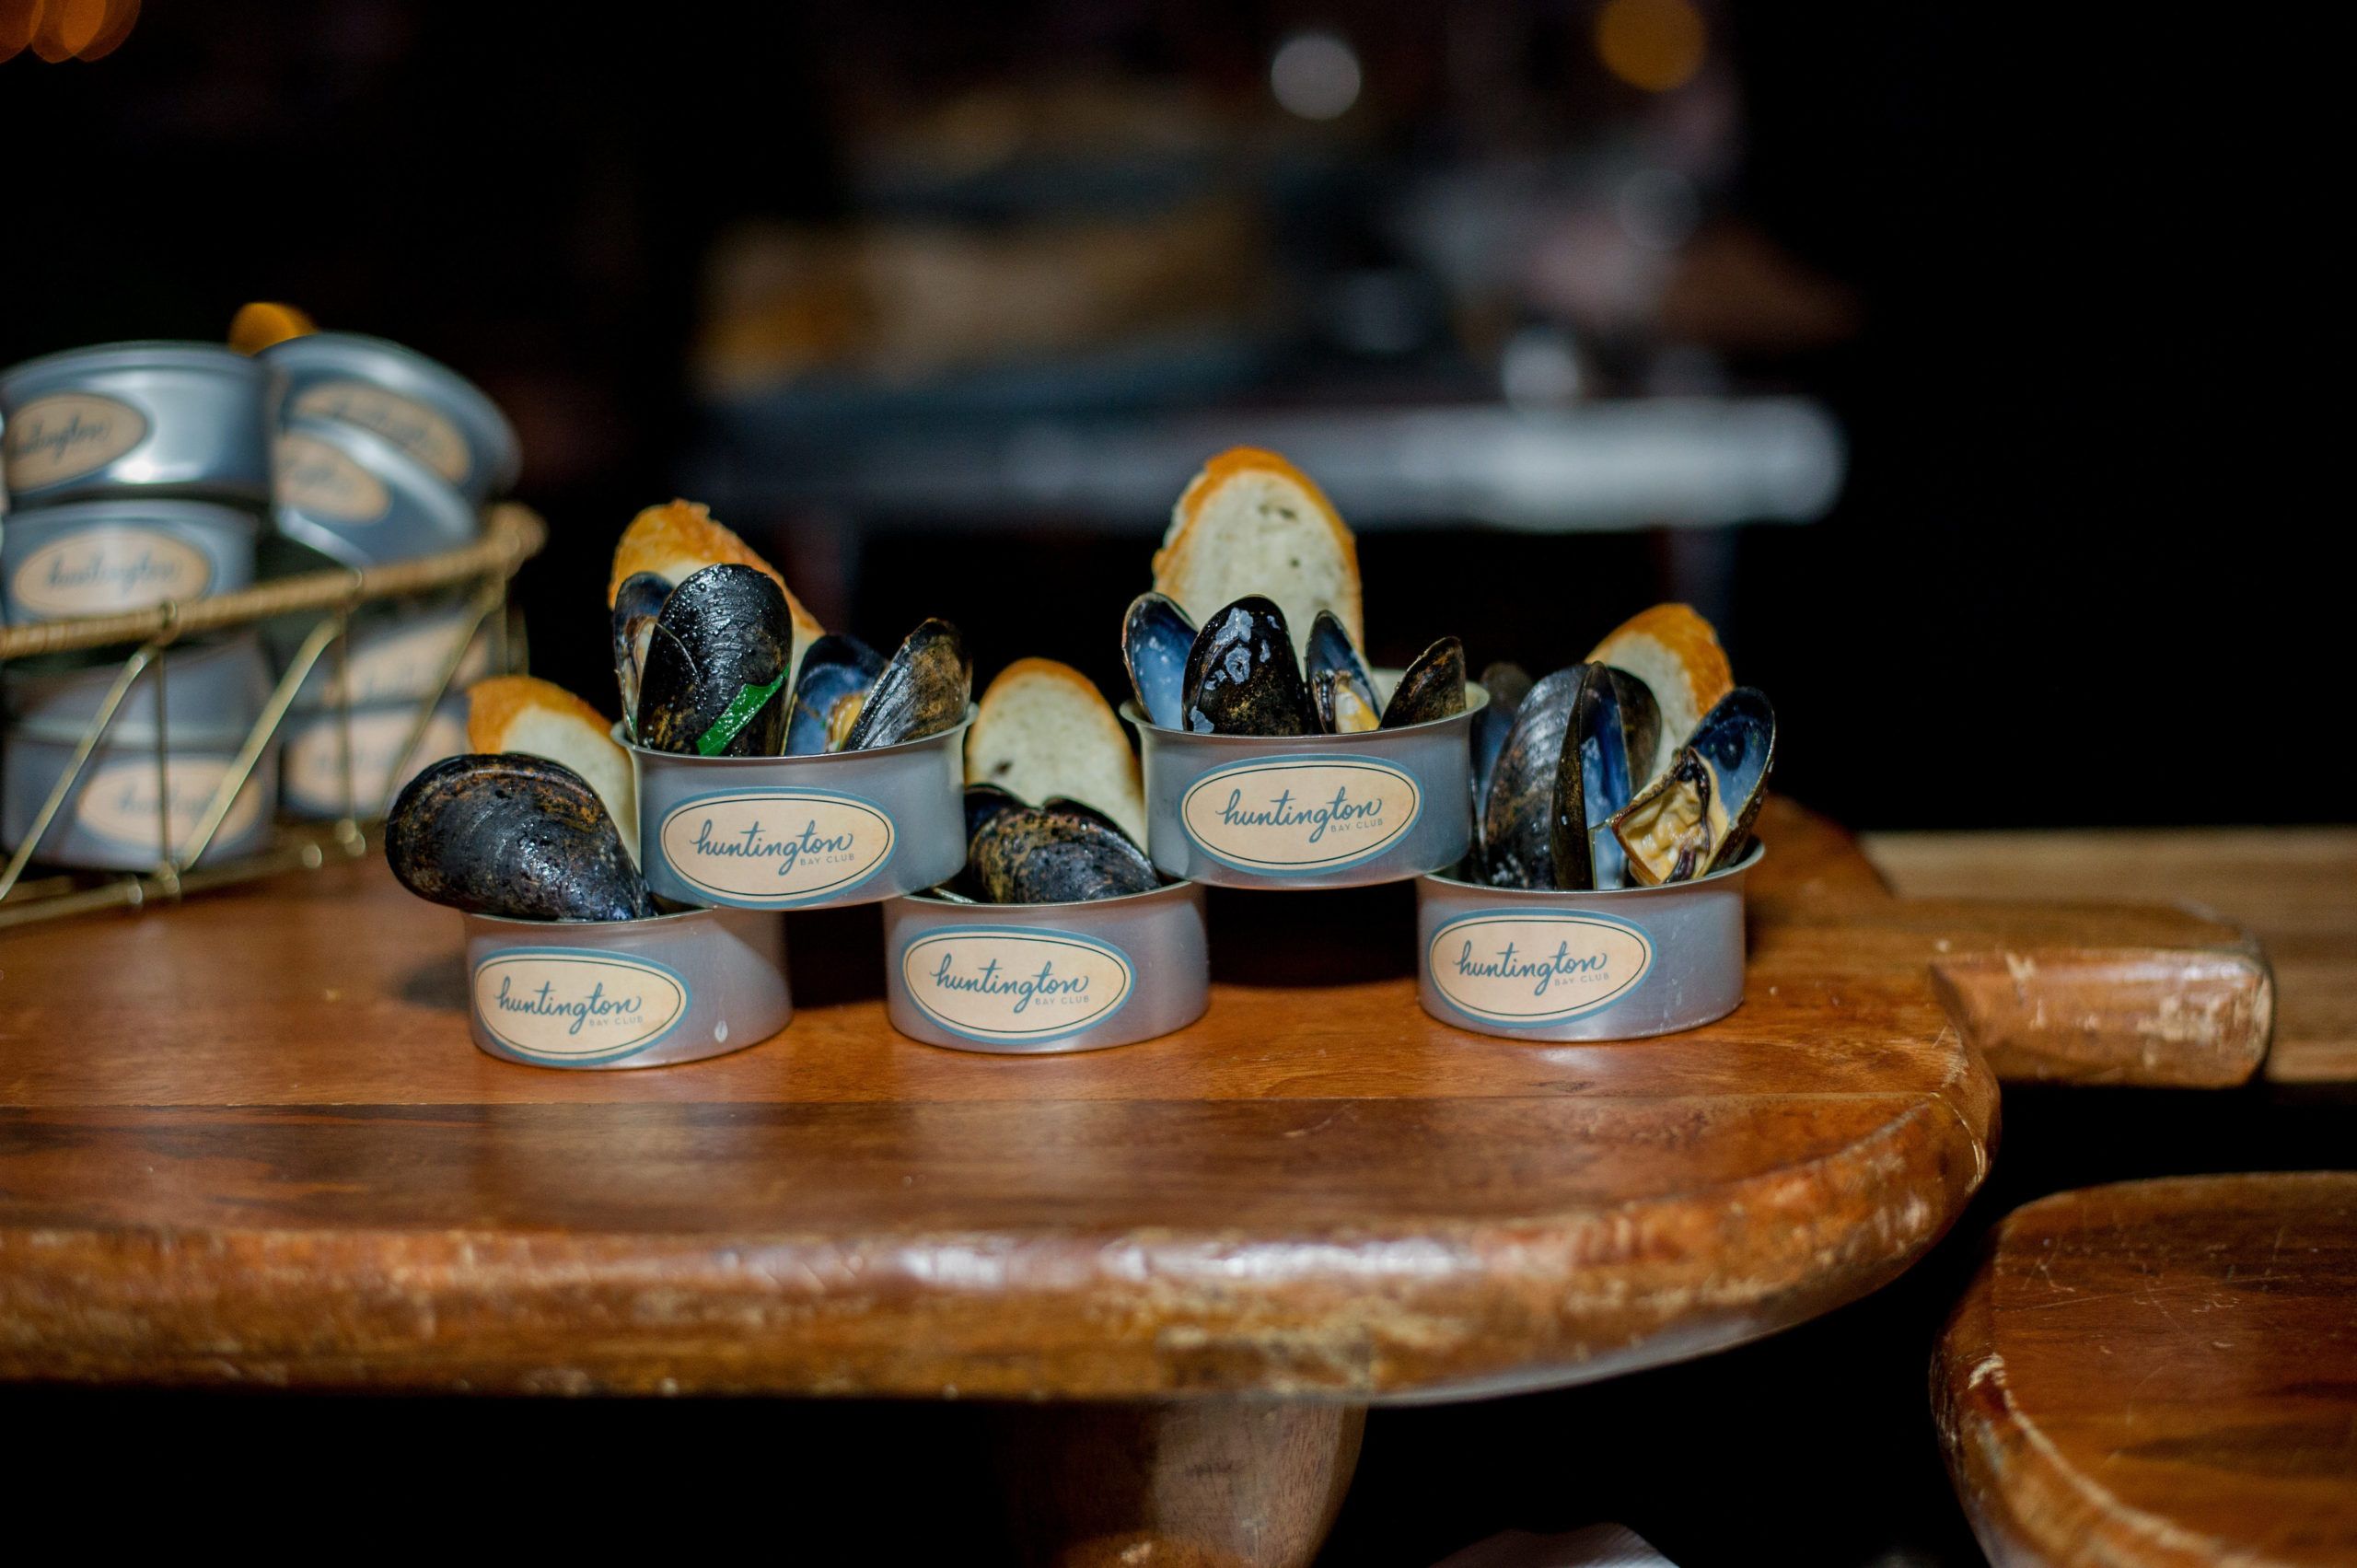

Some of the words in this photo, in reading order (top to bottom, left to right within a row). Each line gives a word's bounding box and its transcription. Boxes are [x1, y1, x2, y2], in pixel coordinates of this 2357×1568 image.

[1214, 785, 1383, 843] huntington
[1330, 823, 1352, 833] BAY
[1356, 818, 1384, 830] CLUB
[689, 819, 854, 876] huntington
[800, 857, 821, 866] BAY
[825, 853, 855, 864] CLUB
[929, 952, 1090, 1014] huntington
[1452, 939, 1608, 996] huntington
[1554, 977, 1575, 987] BAY
[1580, 972, 1610, 983] CLUB
[493, 975, 642, 1036] huntington
[1035, 997, 1056, 1006] BAY
[1061, 994, 1090, 1005] CLUB
[589, 1017, 610, 1027] BAY
[613, 1016, 644, 1026] CLUB
